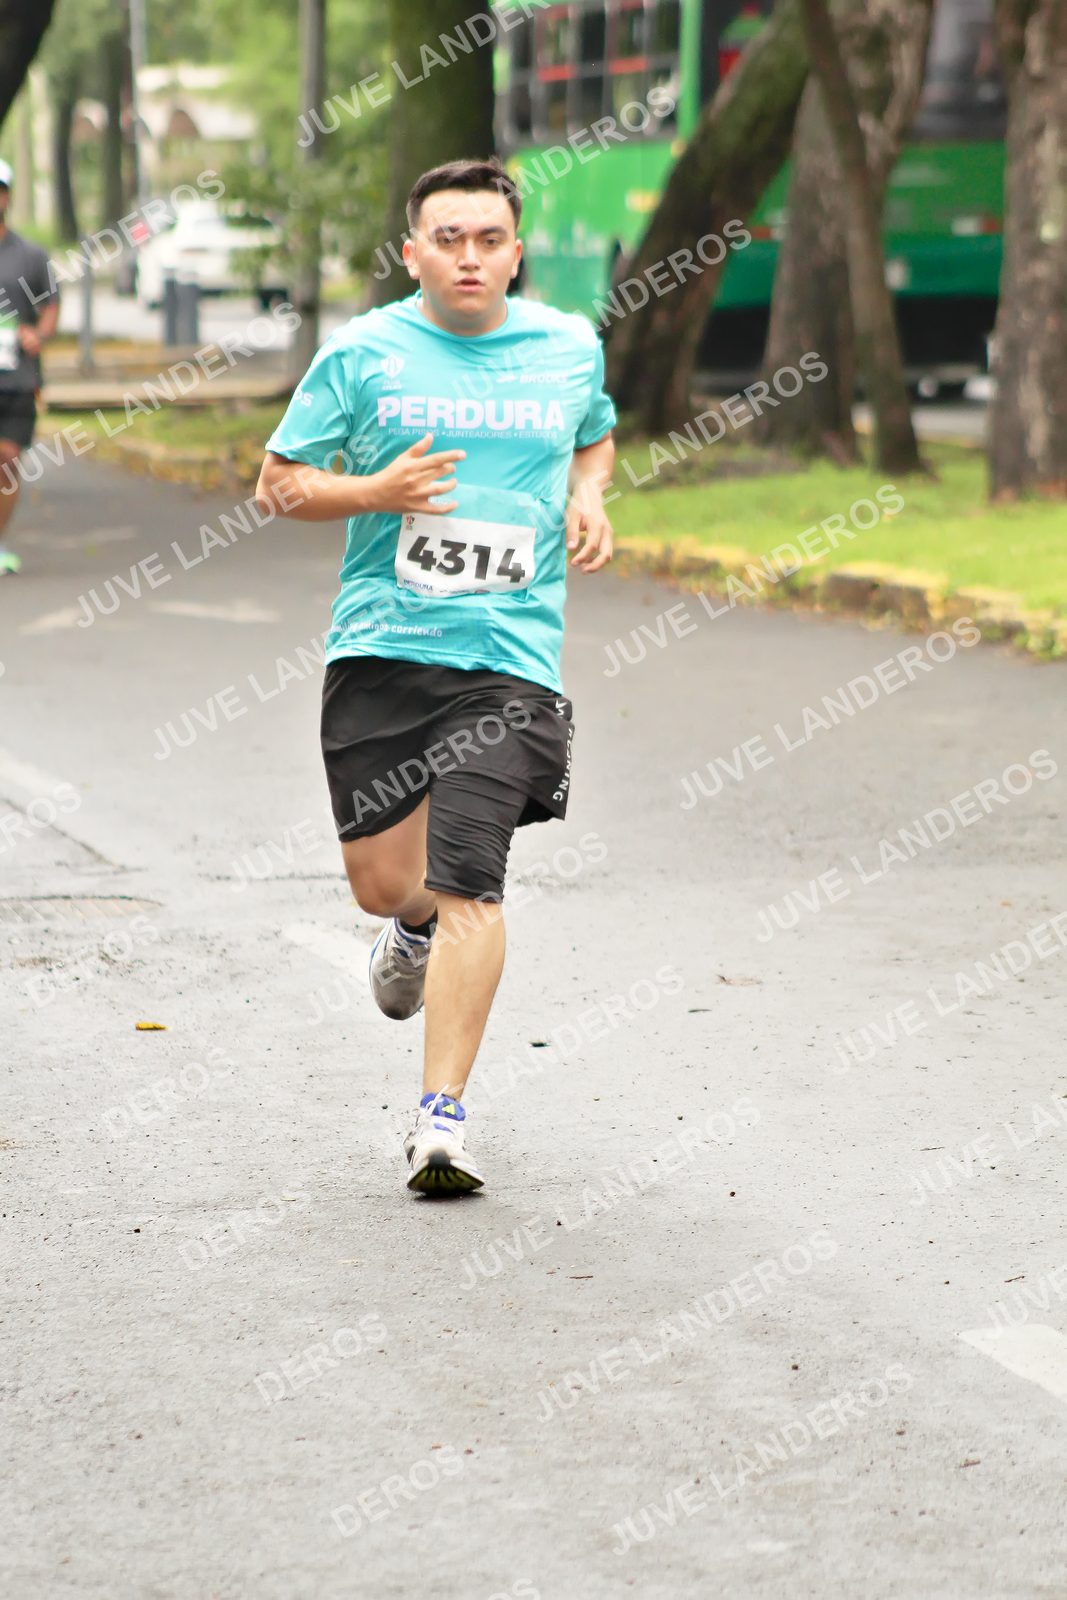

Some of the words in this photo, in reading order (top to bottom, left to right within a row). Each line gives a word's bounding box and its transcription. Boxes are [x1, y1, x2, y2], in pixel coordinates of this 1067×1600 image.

[377, 396, 565, 431] PERDURA
[407, 536, 525, 583] 4314
[391, 625, 442, 637] corriendo
